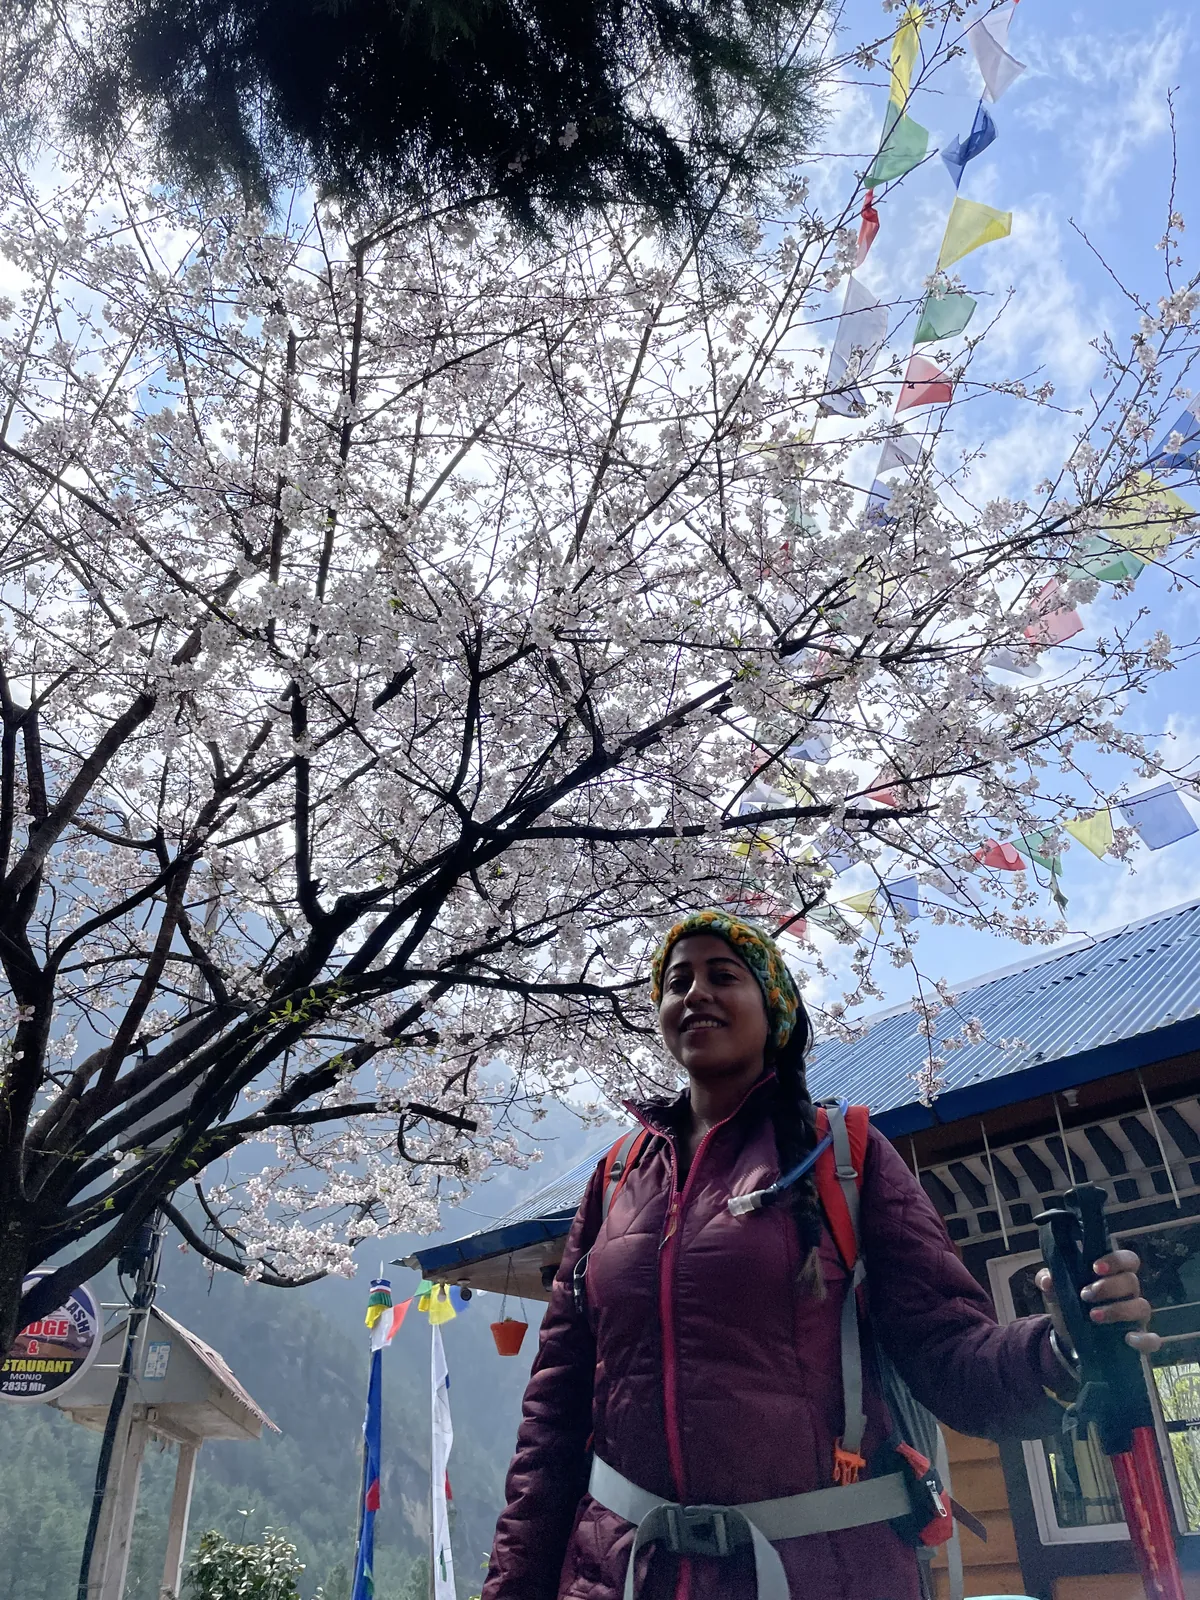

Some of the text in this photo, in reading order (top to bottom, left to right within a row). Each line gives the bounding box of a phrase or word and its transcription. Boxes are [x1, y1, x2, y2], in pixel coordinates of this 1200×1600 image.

[19, 1320, 69, 1337] DGE
[27, 1339, 39, 1355] &
[9, 1373, 42, 1381] MONJO
[1, 1381, 47, 1392] 2835 Mtr
